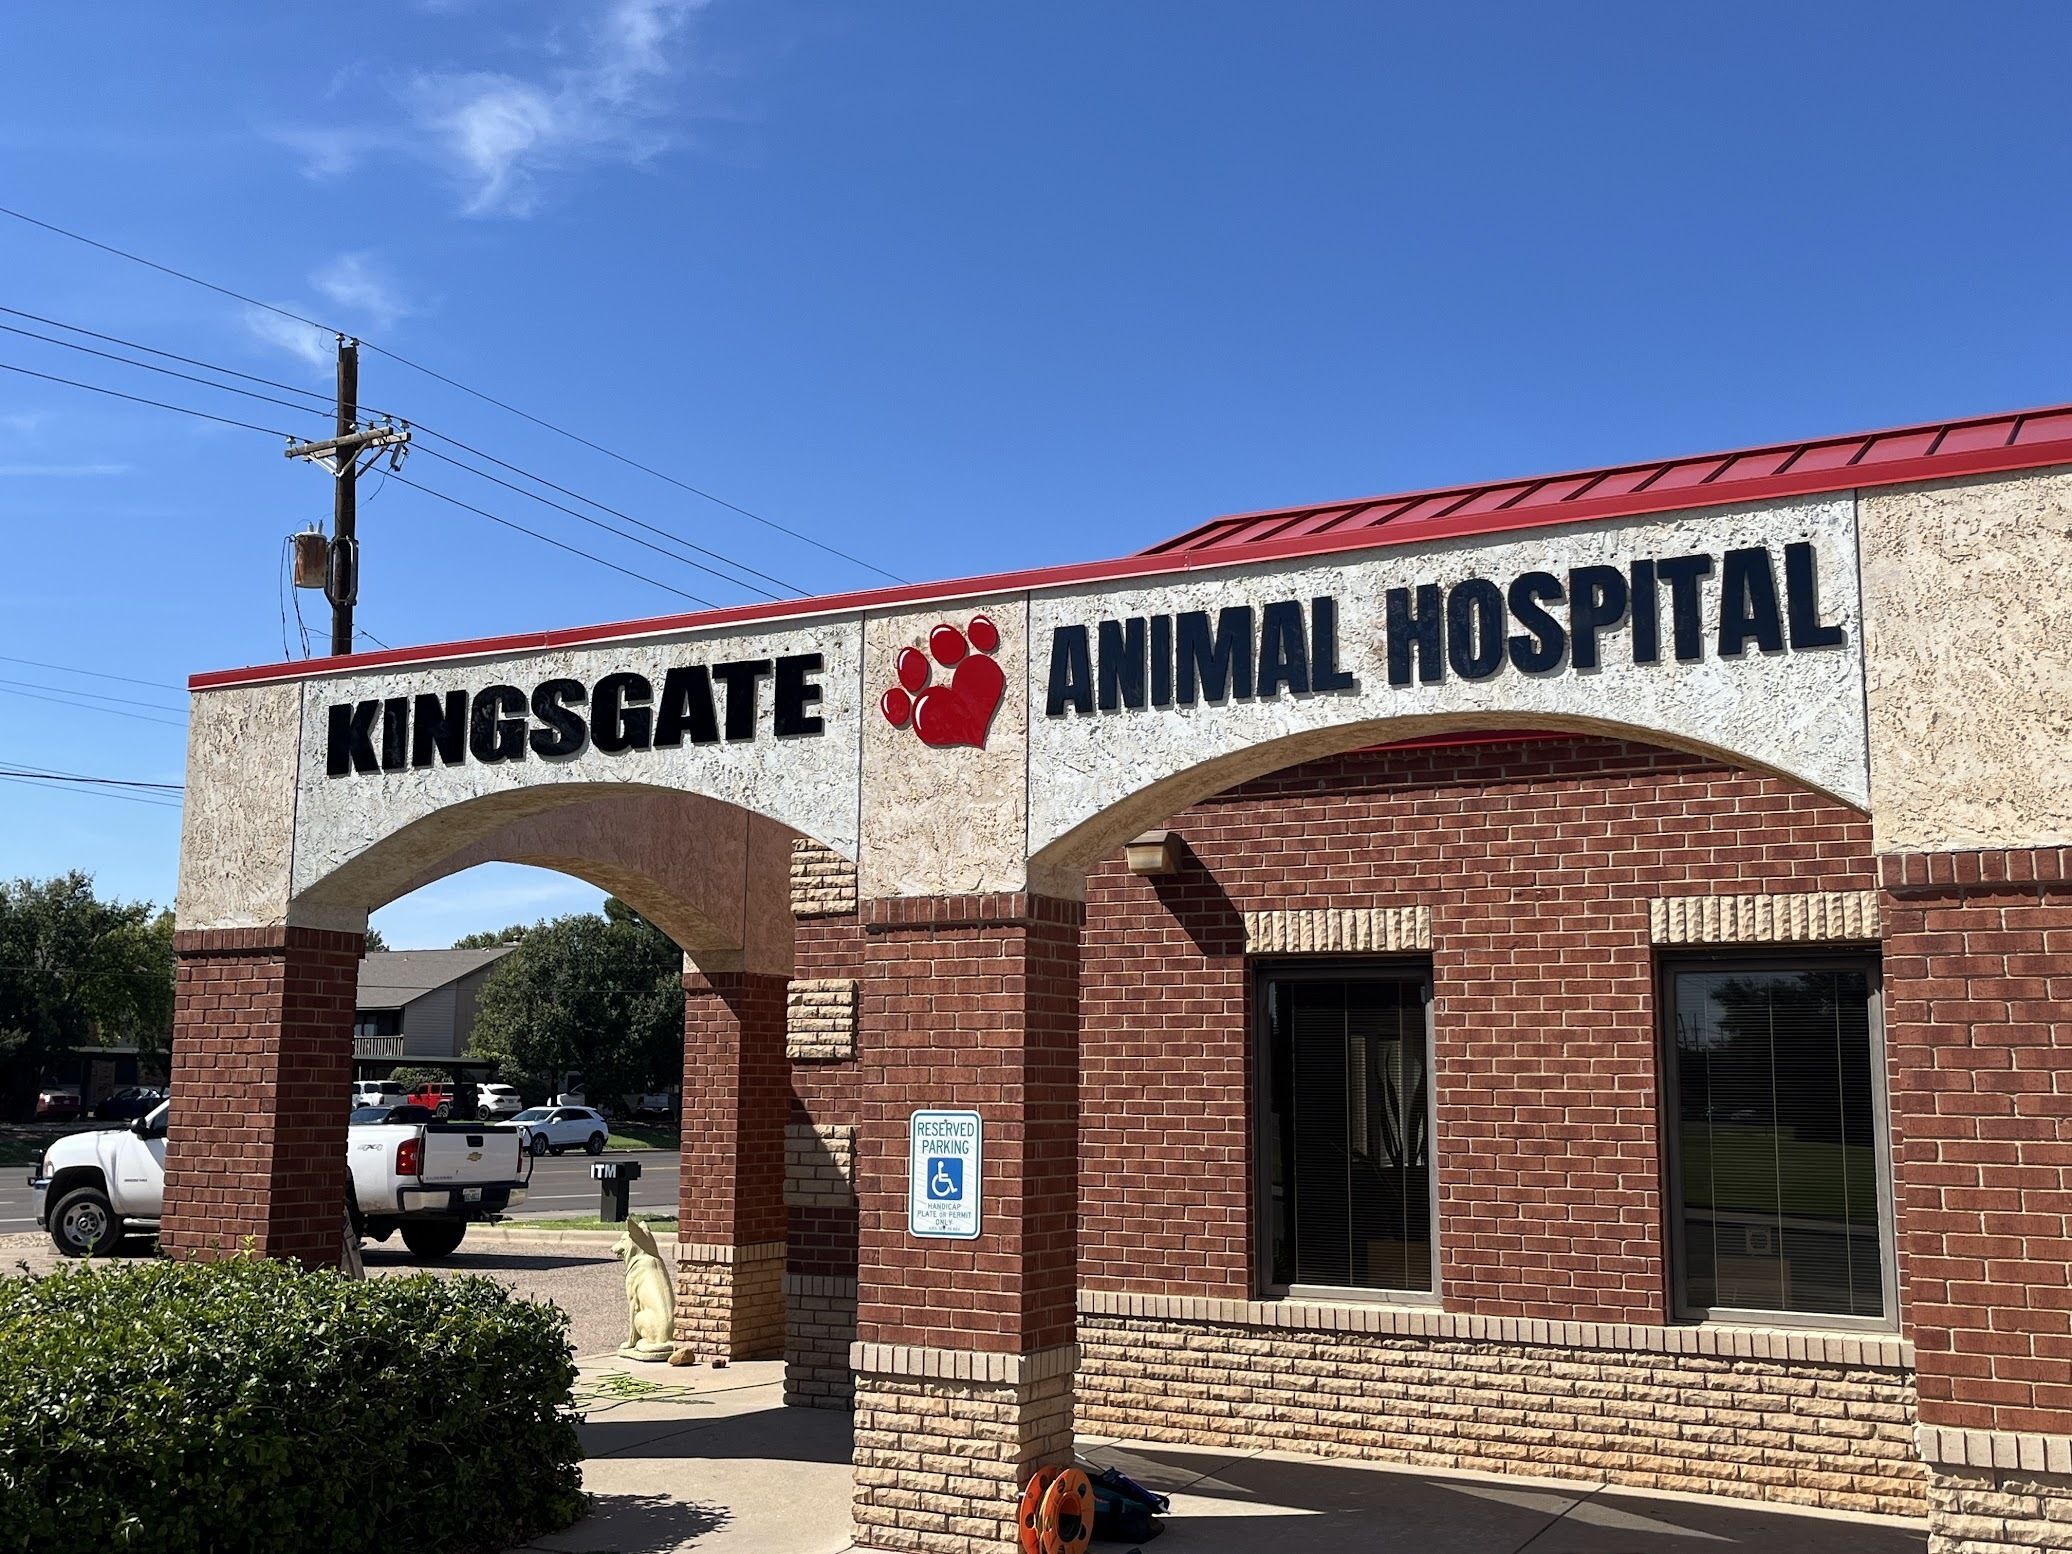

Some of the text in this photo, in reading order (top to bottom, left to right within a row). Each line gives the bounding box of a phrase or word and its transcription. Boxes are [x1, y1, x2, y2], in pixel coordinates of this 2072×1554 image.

[1046, 541, 1843, 717] ANIMAL HOSPITAL
[326, 652, 824, 777] KINGSGATE
[917, 1122, 975, 1137] RESERVED
[921, 1139, 969, 1154] PARKING
[927, 1202, 962, 1211] HANDICAP
[917, 1210, 937, 1218] PLATE
[948, 1211, 972, 1219] PERMIT
[935, 1218, 953, 1226] ONLY
